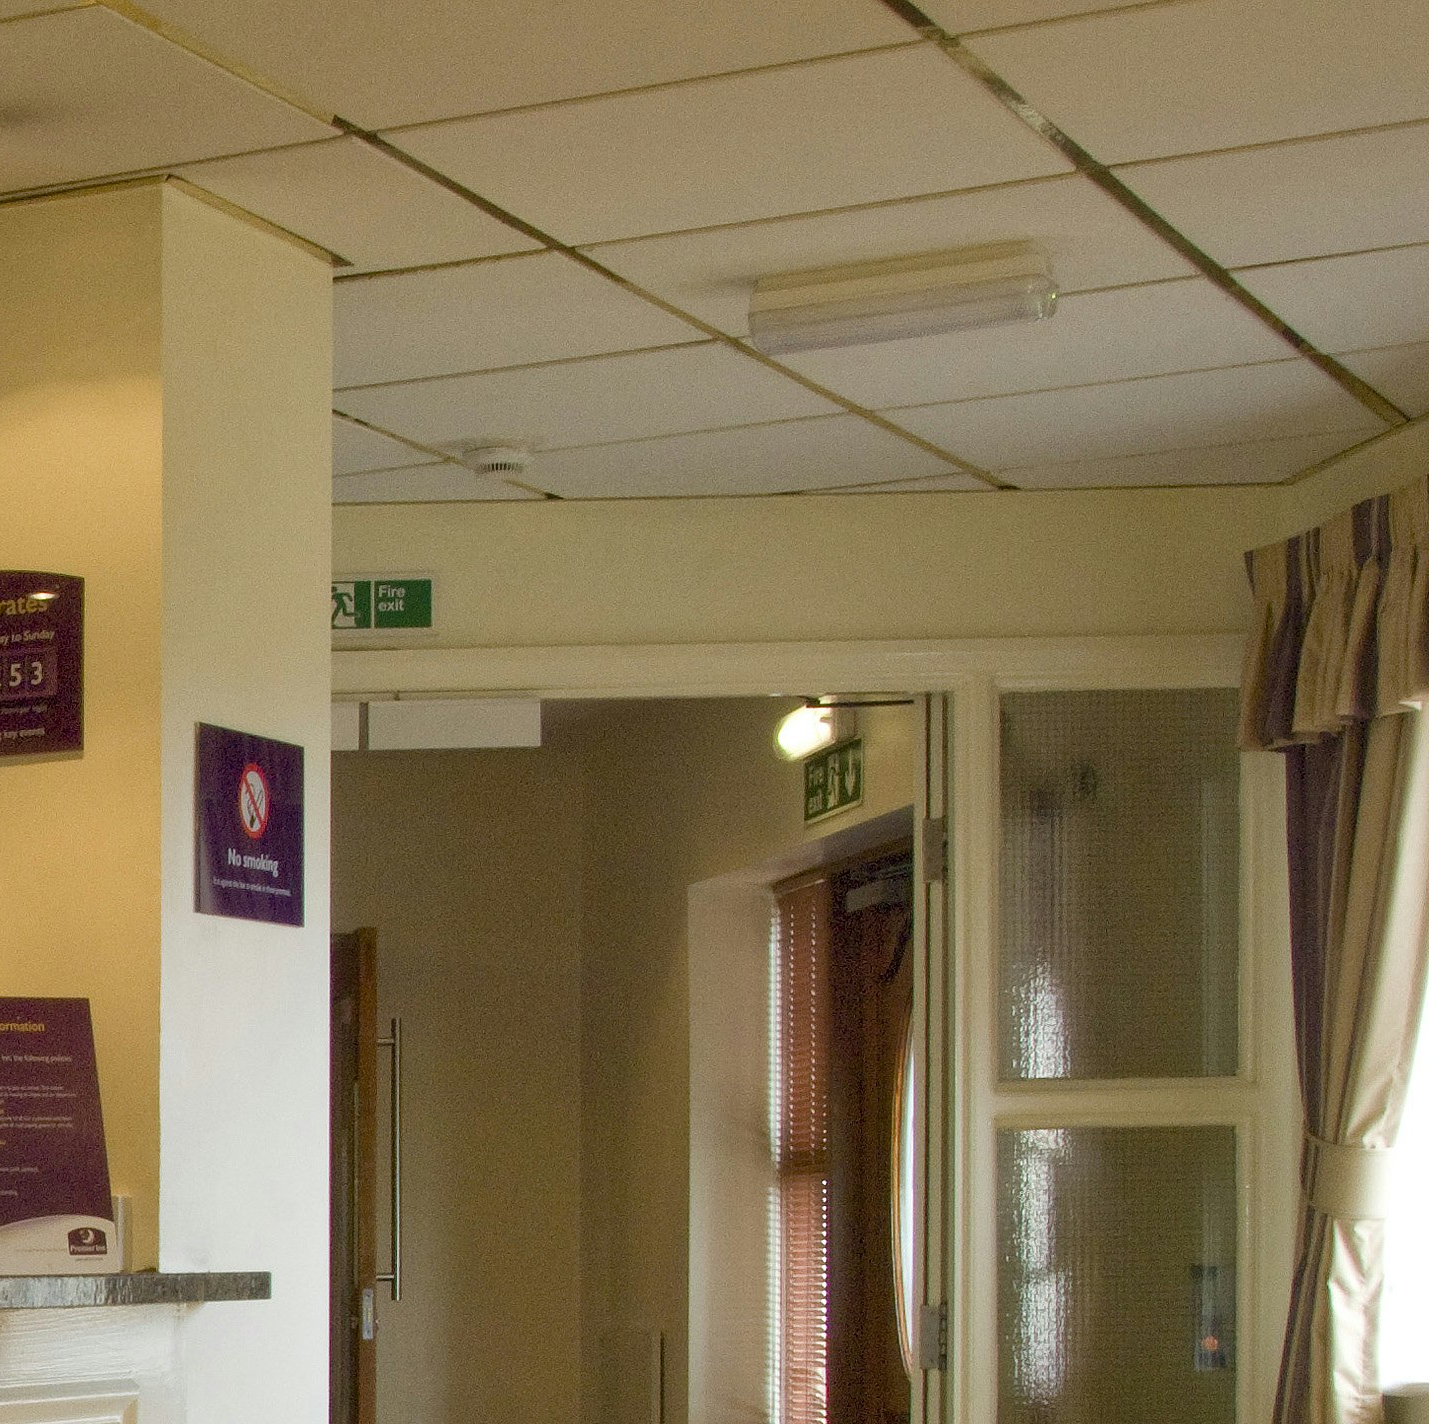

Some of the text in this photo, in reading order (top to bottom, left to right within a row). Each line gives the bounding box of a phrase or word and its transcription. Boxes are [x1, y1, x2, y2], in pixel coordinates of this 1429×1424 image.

[378, 585, 406, 598] Fire
[377, 599, 406, 612] exit
[23, 630, 56, 642] Sunday
[227, 847, 279, 878] No smoking
